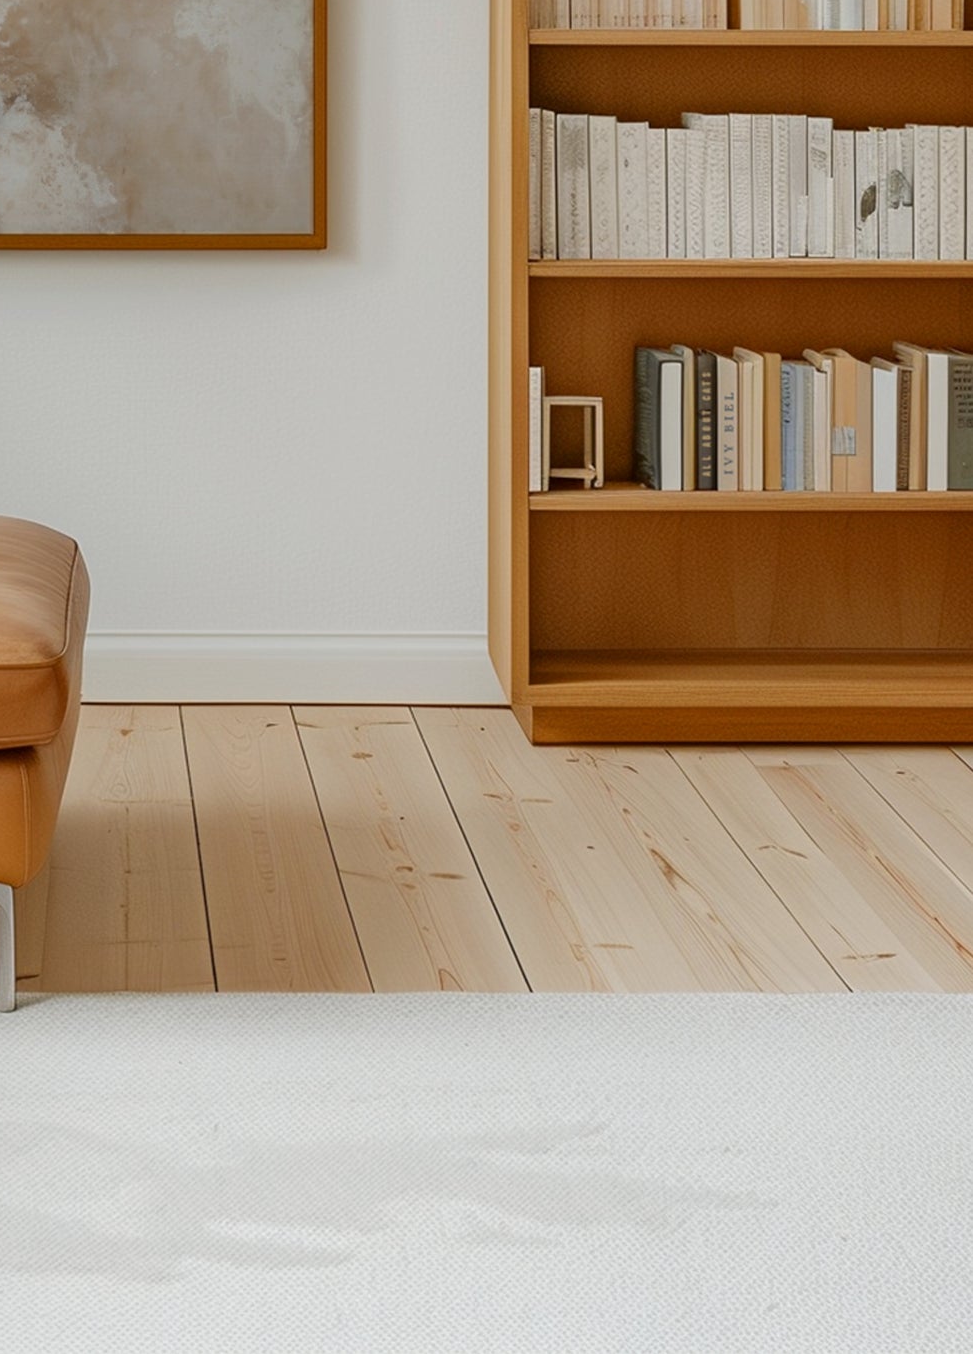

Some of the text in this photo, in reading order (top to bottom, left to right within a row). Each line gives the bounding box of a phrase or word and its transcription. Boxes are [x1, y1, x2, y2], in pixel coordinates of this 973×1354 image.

[701, 371, 712, 477] ALL ABOUT CATS
[724, 392, 734, 474] IVY BIEL
